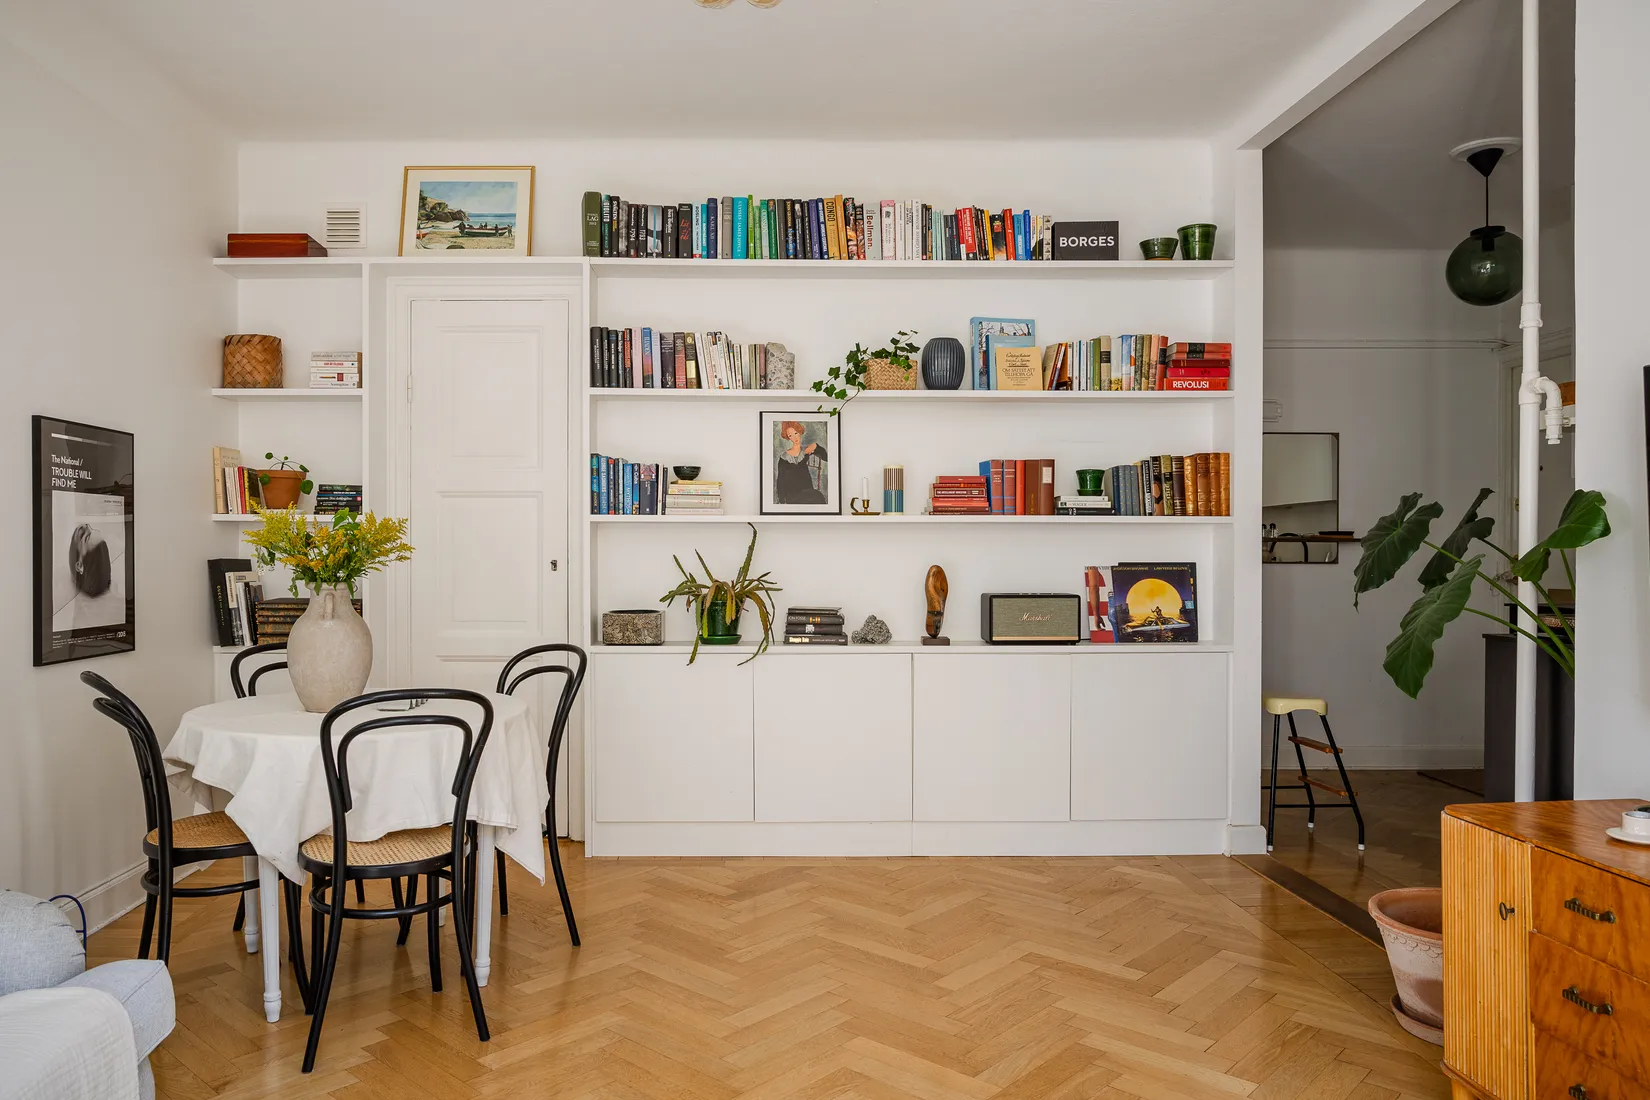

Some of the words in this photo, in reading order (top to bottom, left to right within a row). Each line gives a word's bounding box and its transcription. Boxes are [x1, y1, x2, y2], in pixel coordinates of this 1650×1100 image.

[826, 201, 835, 221] CONGO
[1060, 236, 1115, 247] BORGES
[52, 454, 60, 463] The
[61, 456, 79, 466] National
[52, 467, 78, 478] TROUBLE
[79, 470, 92, 479] WILL
[52, 478, 66, 487] FIND
[67, 480, 76, 488] ME
[1019, 612, 1052, 621] Marshall
